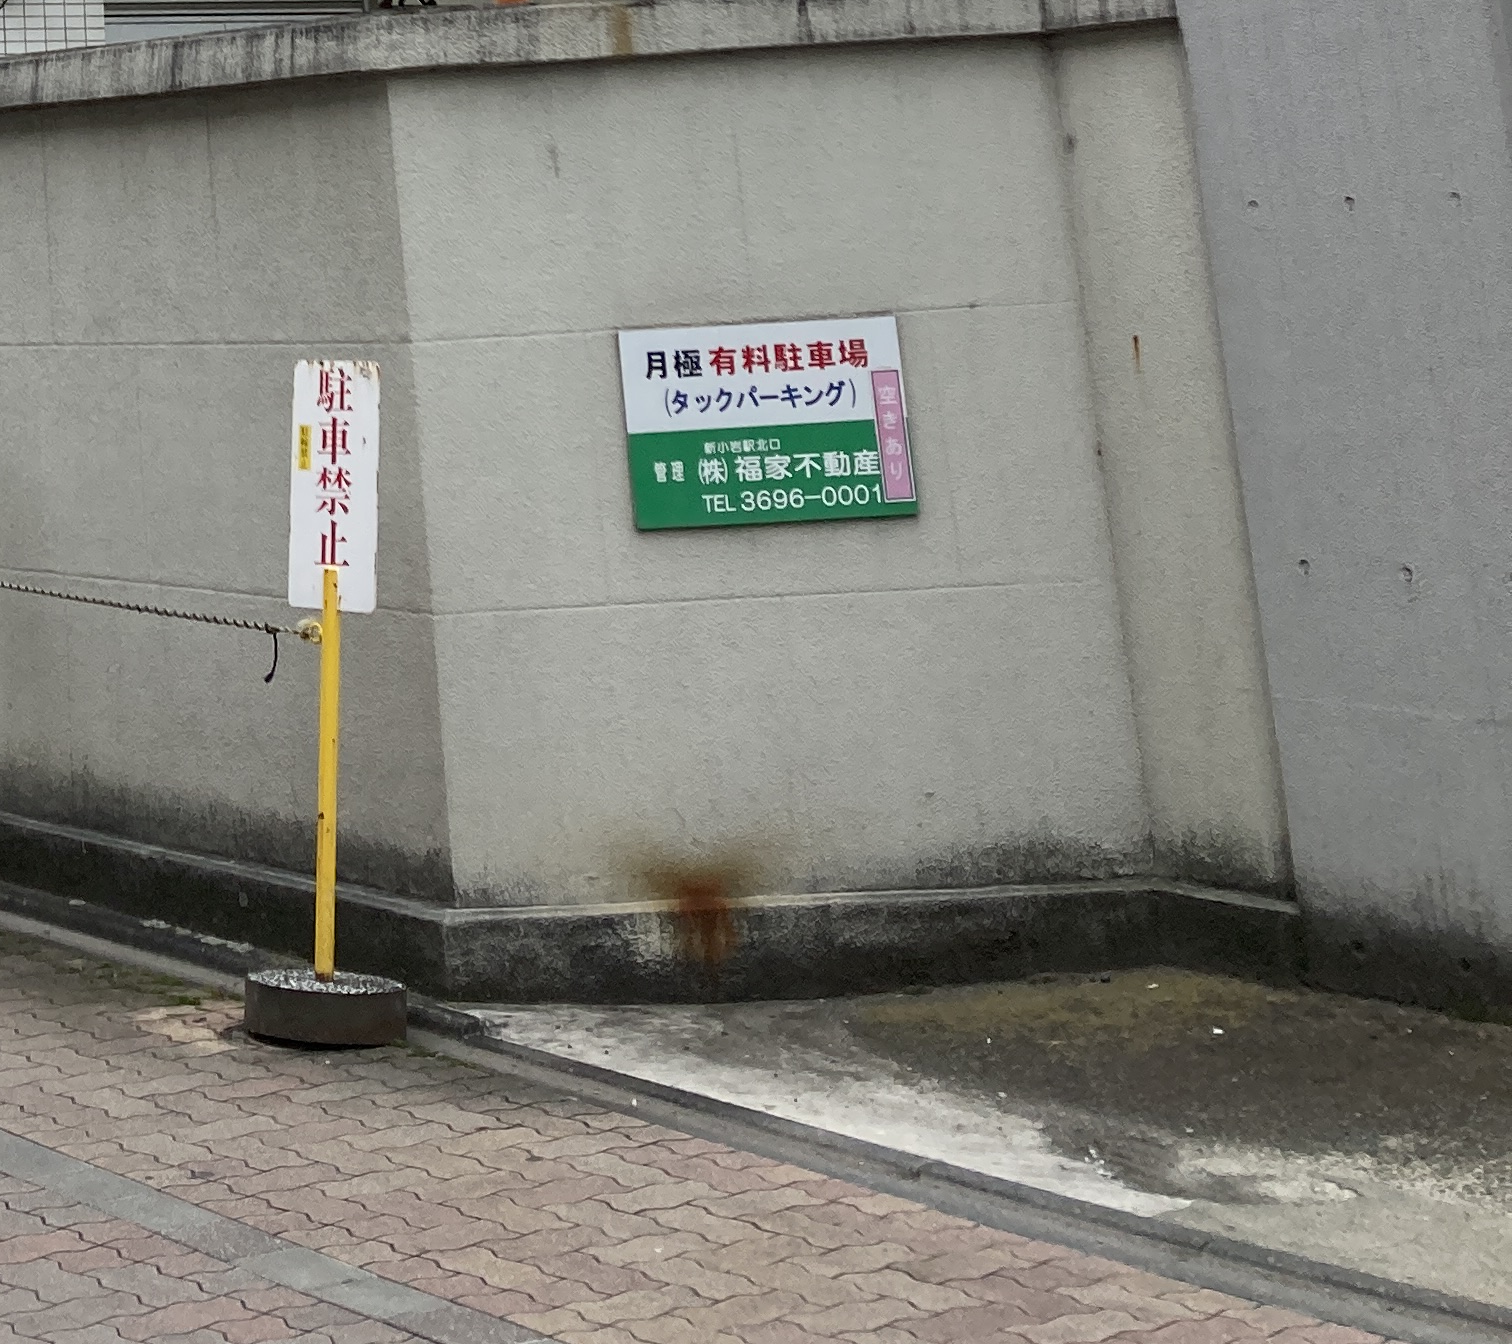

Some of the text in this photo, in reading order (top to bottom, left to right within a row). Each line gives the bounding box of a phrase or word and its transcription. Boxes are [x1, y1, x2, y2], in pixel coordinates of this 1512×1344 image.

[664, 378, 857, 418] (タックパーキング)
[704, 439, 781, 454] 新小岩駅北口
[877, 385, 904, 481] 空きあり
[314, 368, 354, 567] 駐車禁止
[654, 461, 685, 483] 管理
[702, 484, 882, 513] TEL 3696-0001
